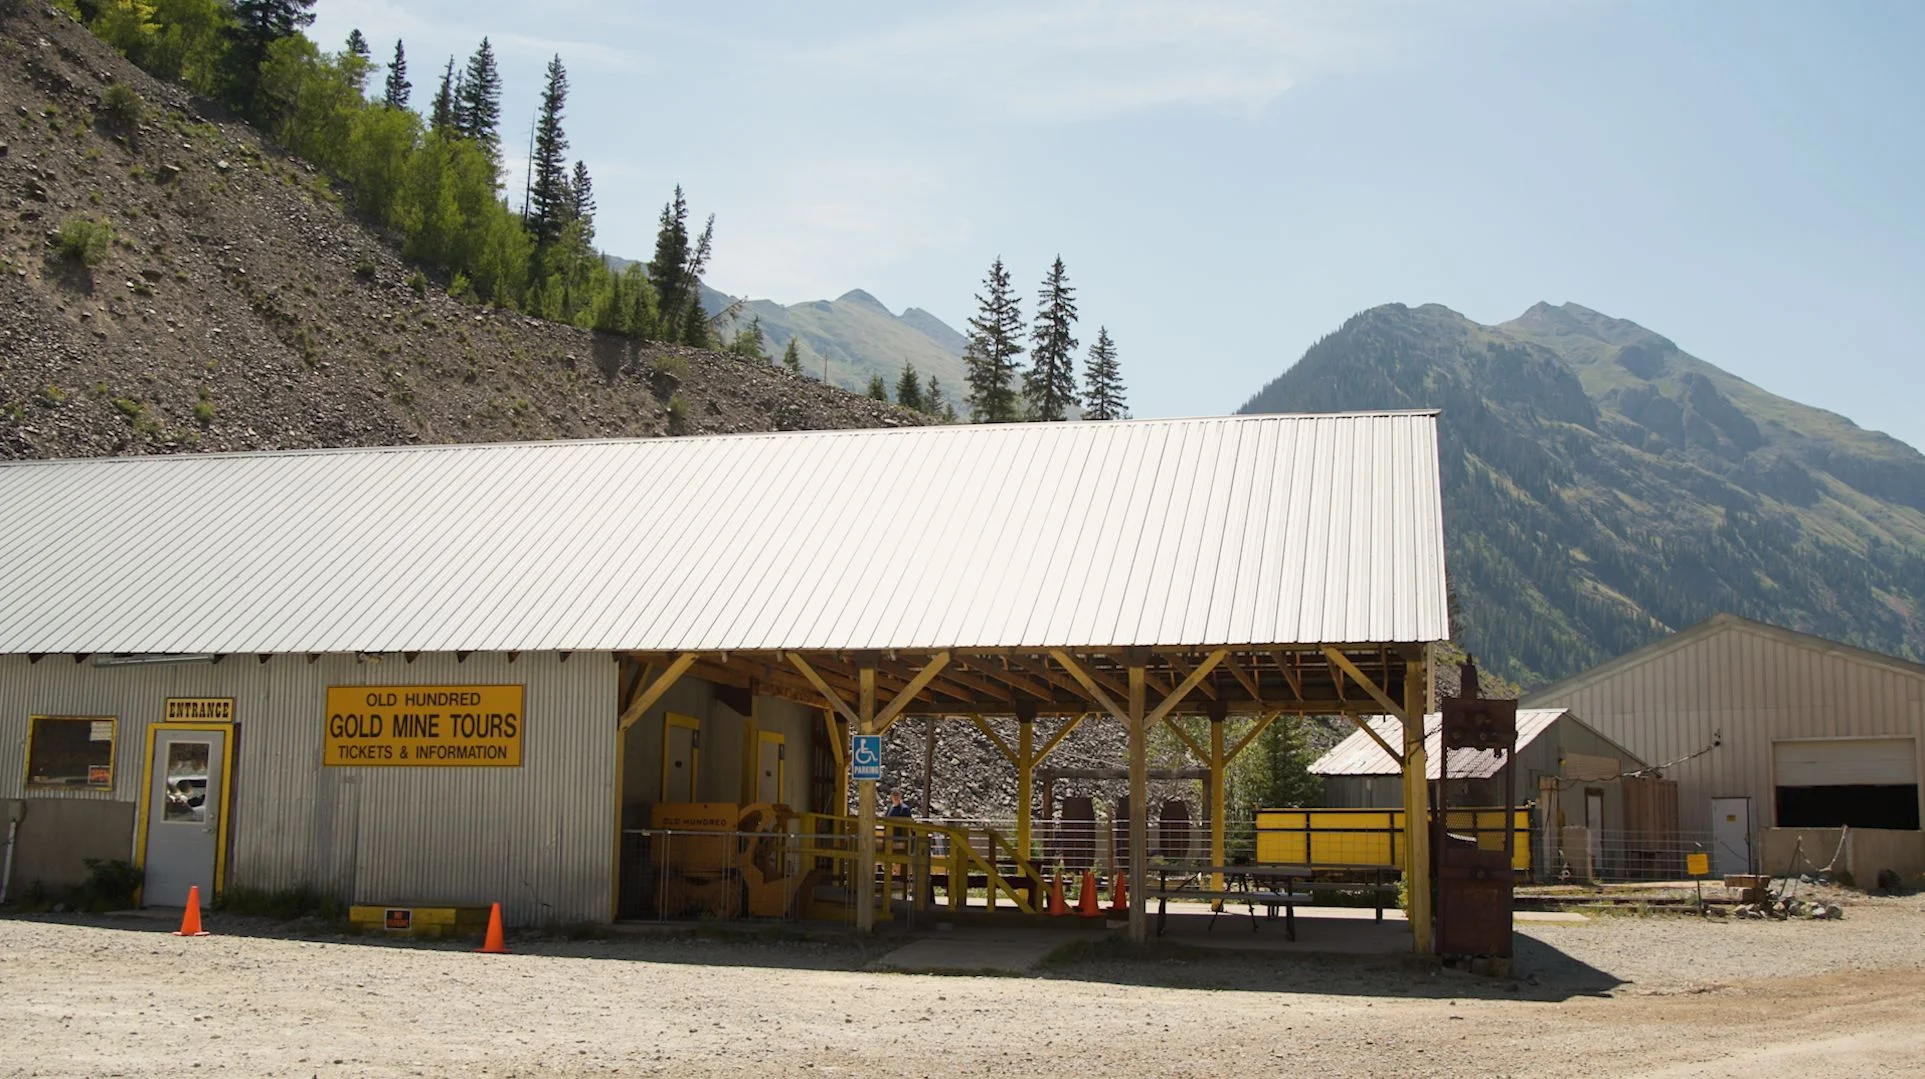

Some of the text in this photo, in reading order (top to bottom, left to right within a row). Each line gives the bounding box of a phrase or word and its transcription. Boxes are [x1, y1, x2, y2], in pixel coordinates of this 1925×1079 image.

[366, 692, 481, 707] OLD HUNDRED
[169, 702, 229, 718] ENTRANCE
[330, 713, 517, 739] GOLD MINE TOURS
[338, 745, 507, 760] TICKETS & INFORMATION
[854, 765, 879, 775] PARKING
[683, 818, 728, 826] HUNDRED
